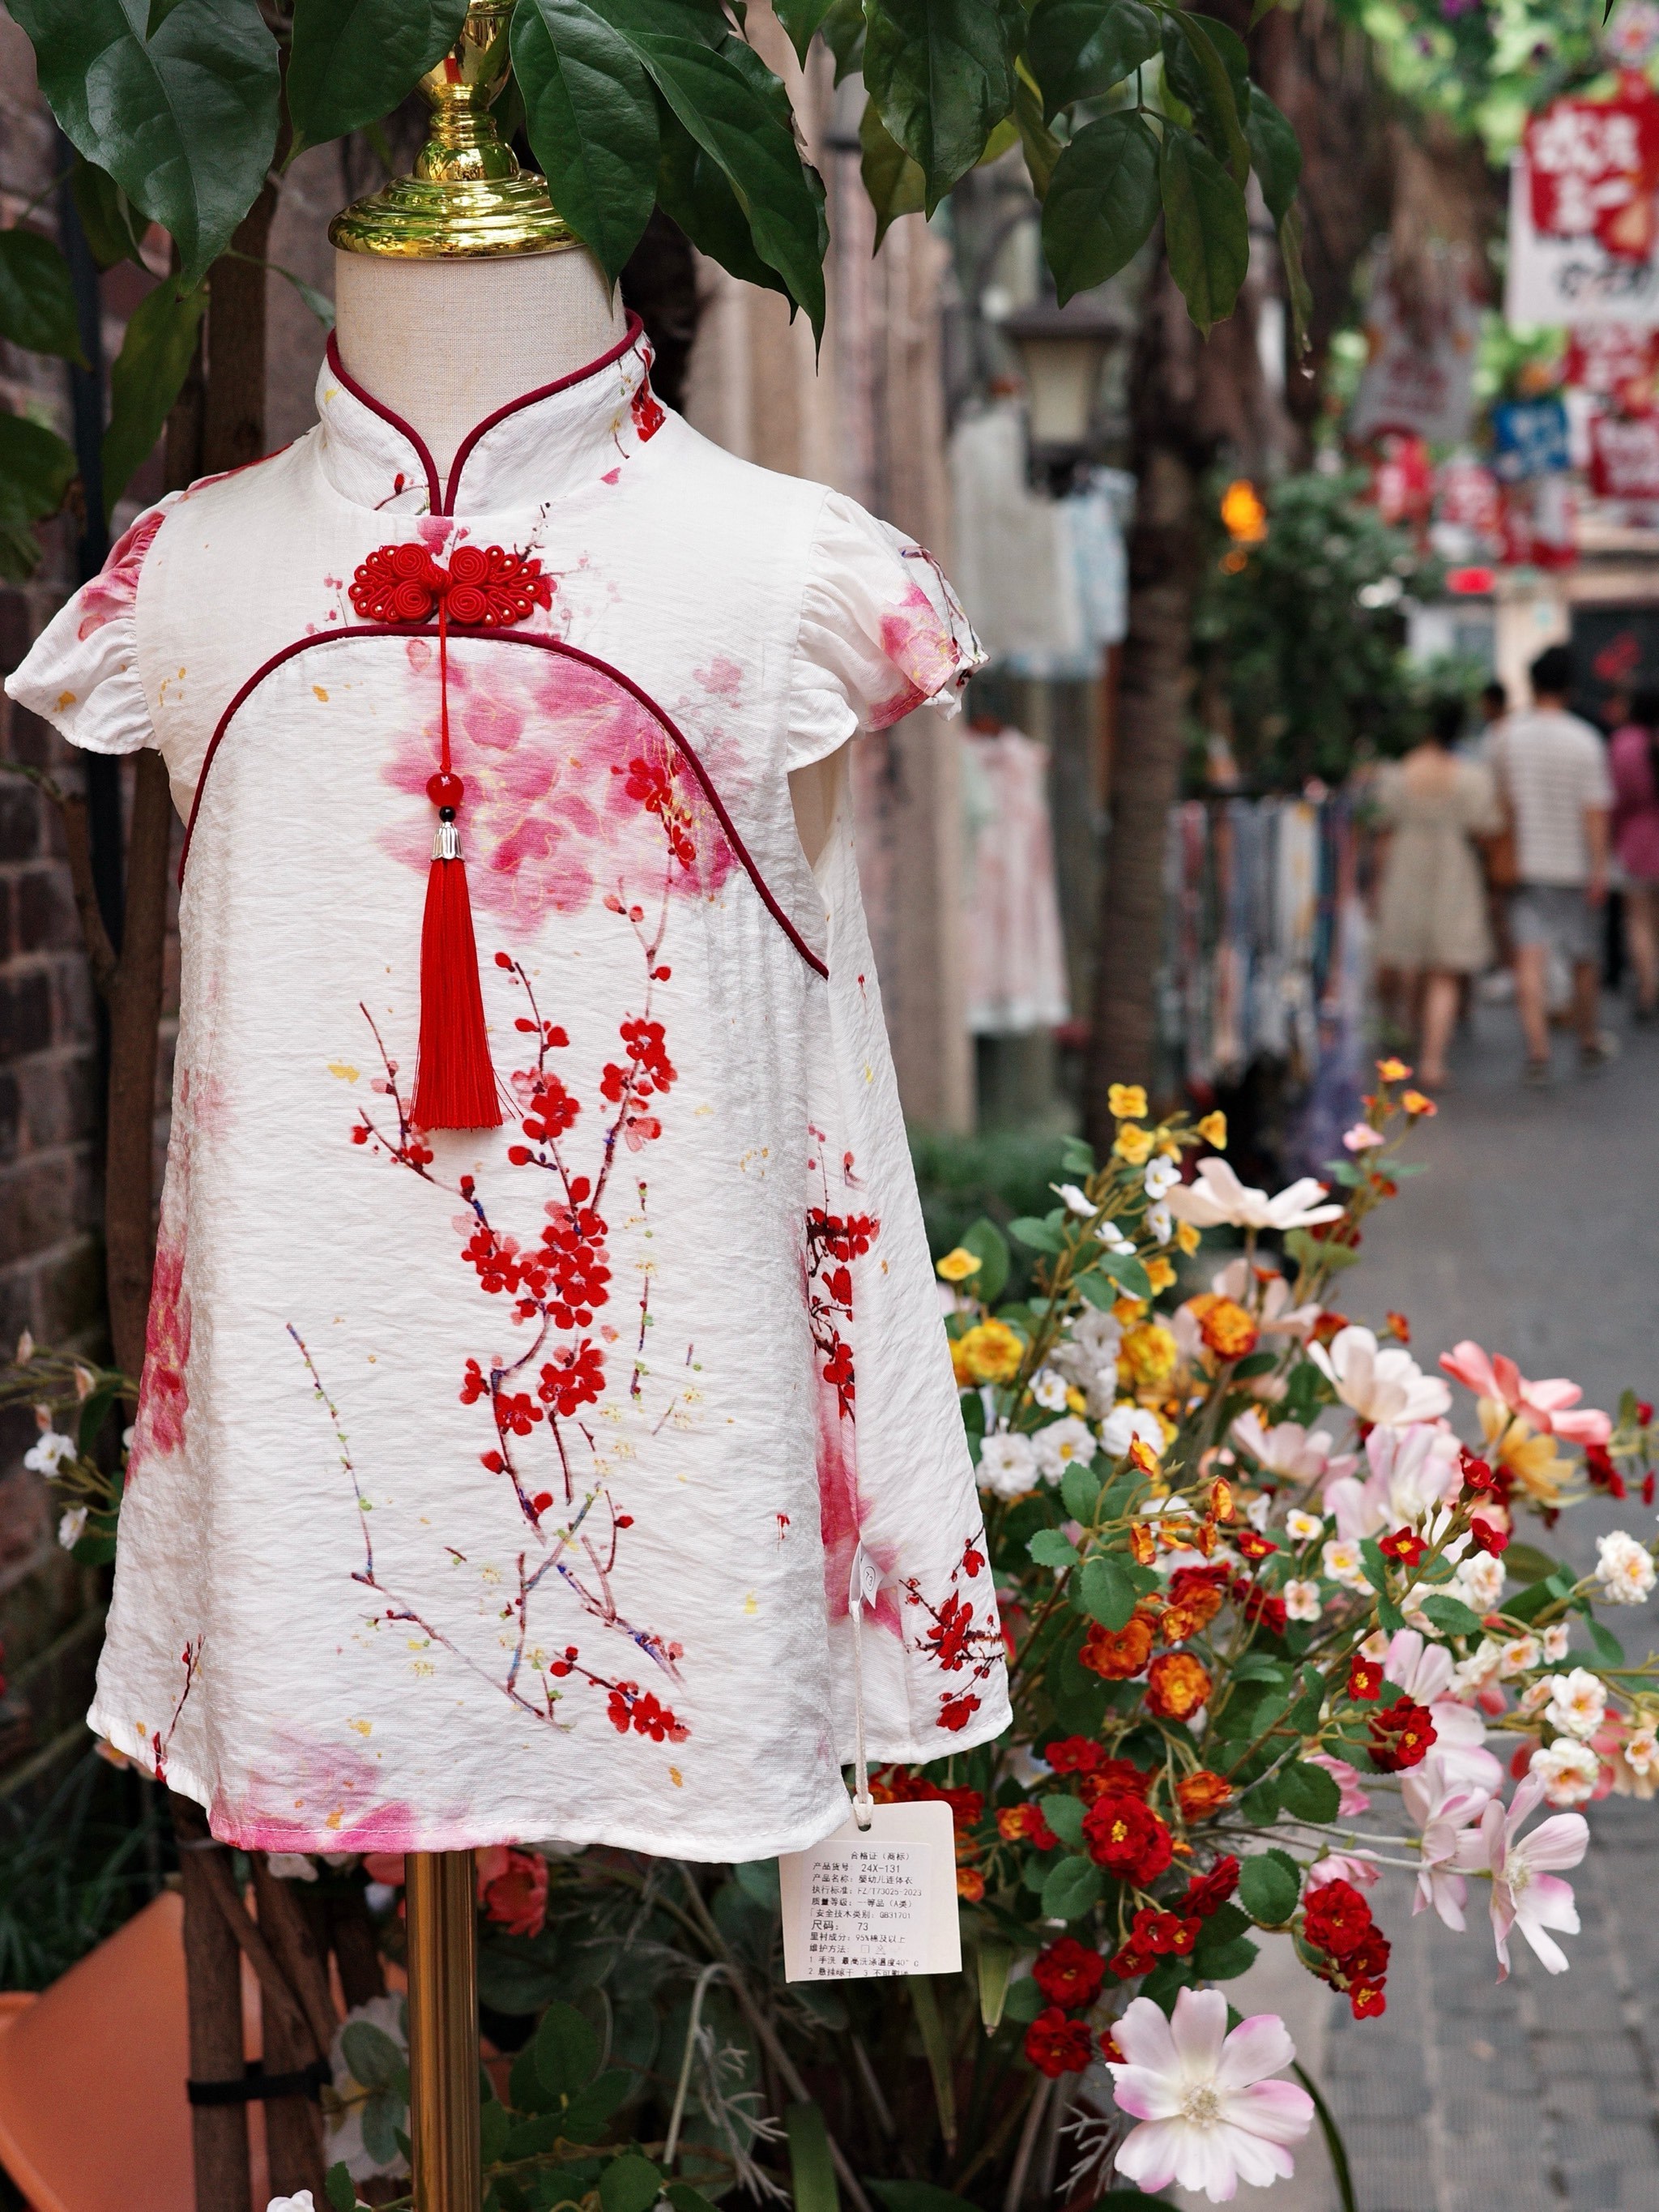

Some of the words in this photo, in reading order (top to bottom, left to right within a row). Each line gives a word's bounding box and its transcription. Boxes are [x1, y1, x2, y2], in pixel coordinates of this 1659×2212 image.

[865, 1571, 873, 1586] 73
[861, 1864, 900, 1873] 24X-131
[857, 1922, 869, 1931] 73
